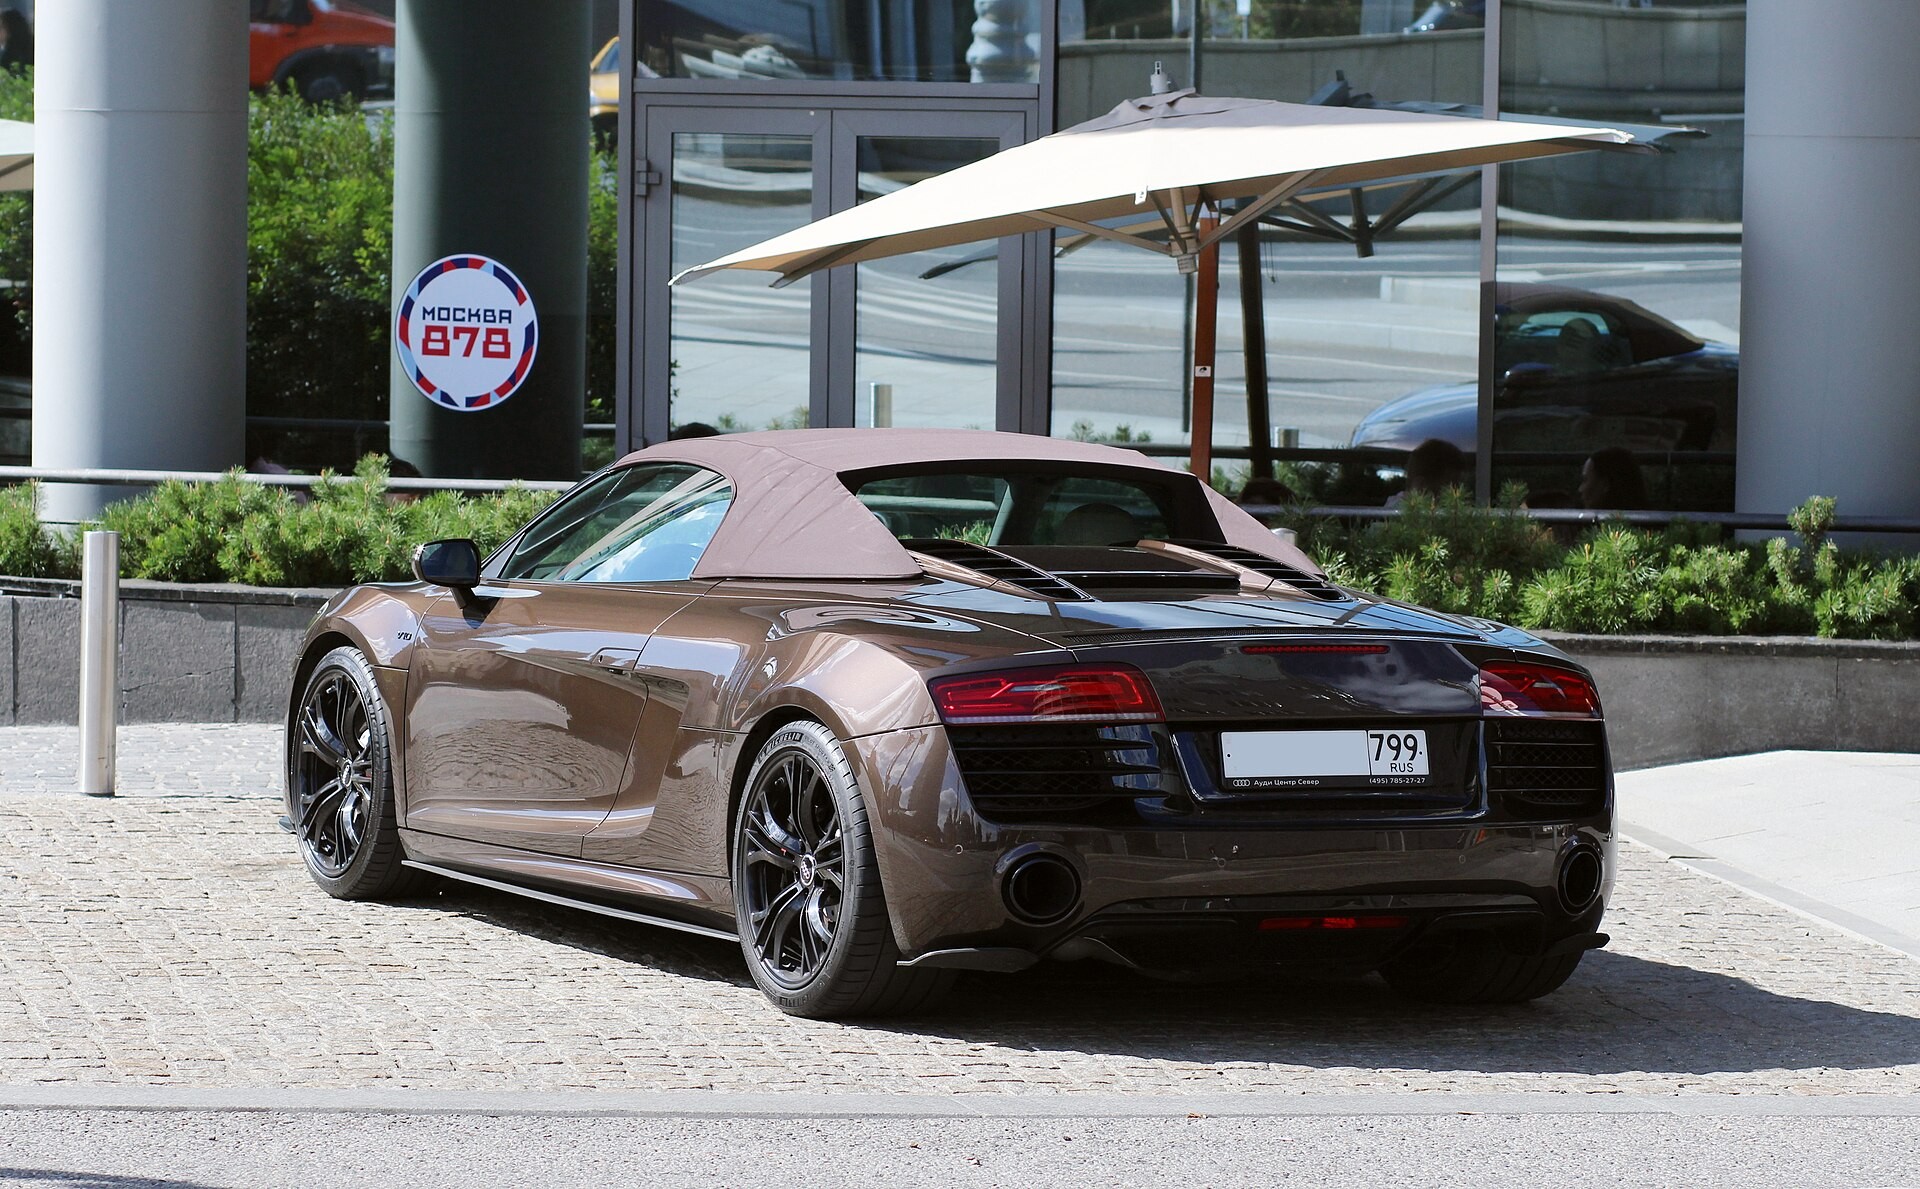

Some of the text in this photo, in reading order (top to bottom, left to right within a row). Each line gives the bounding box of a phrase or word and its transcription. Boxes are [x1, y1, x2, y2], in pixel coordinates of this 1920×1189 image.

[422, 306, 512, 324] МОСКВА
[422, 325, 511, 359] 878
[1369, 733, 1418, 761] 799
[1390, 762, 1414, 773] RUS
[1253, 778, 1320, 787] Ауди Центр Север
[1369, 777, 1388, 785] (495)
